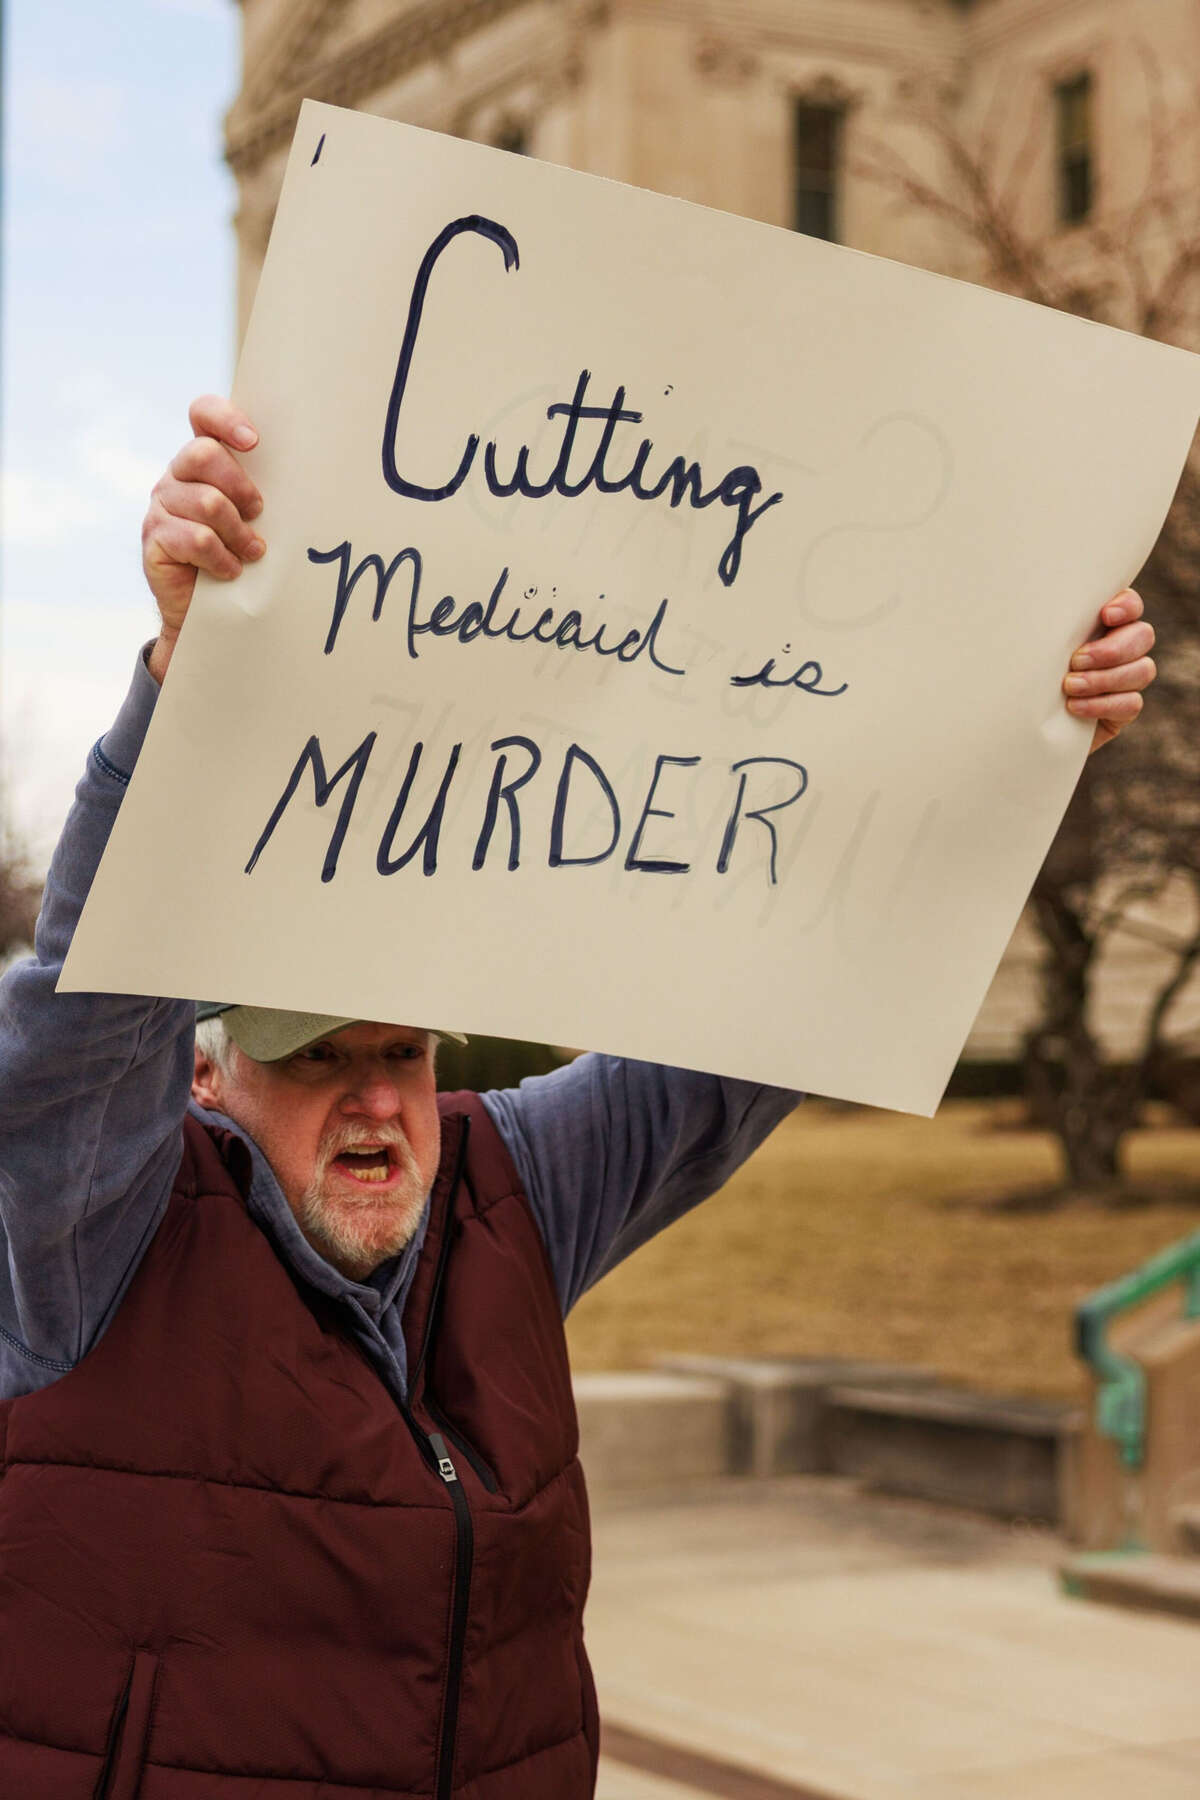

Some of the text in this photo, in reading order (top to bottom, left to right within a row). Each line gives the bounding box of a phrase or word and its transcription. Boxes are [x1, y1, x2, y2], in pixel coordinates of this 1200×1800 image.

[382, 213, 784, 588] Cutting
[306, 540, 849, 698] Medicaid is
[244, 731, 809, 885] MURDER
